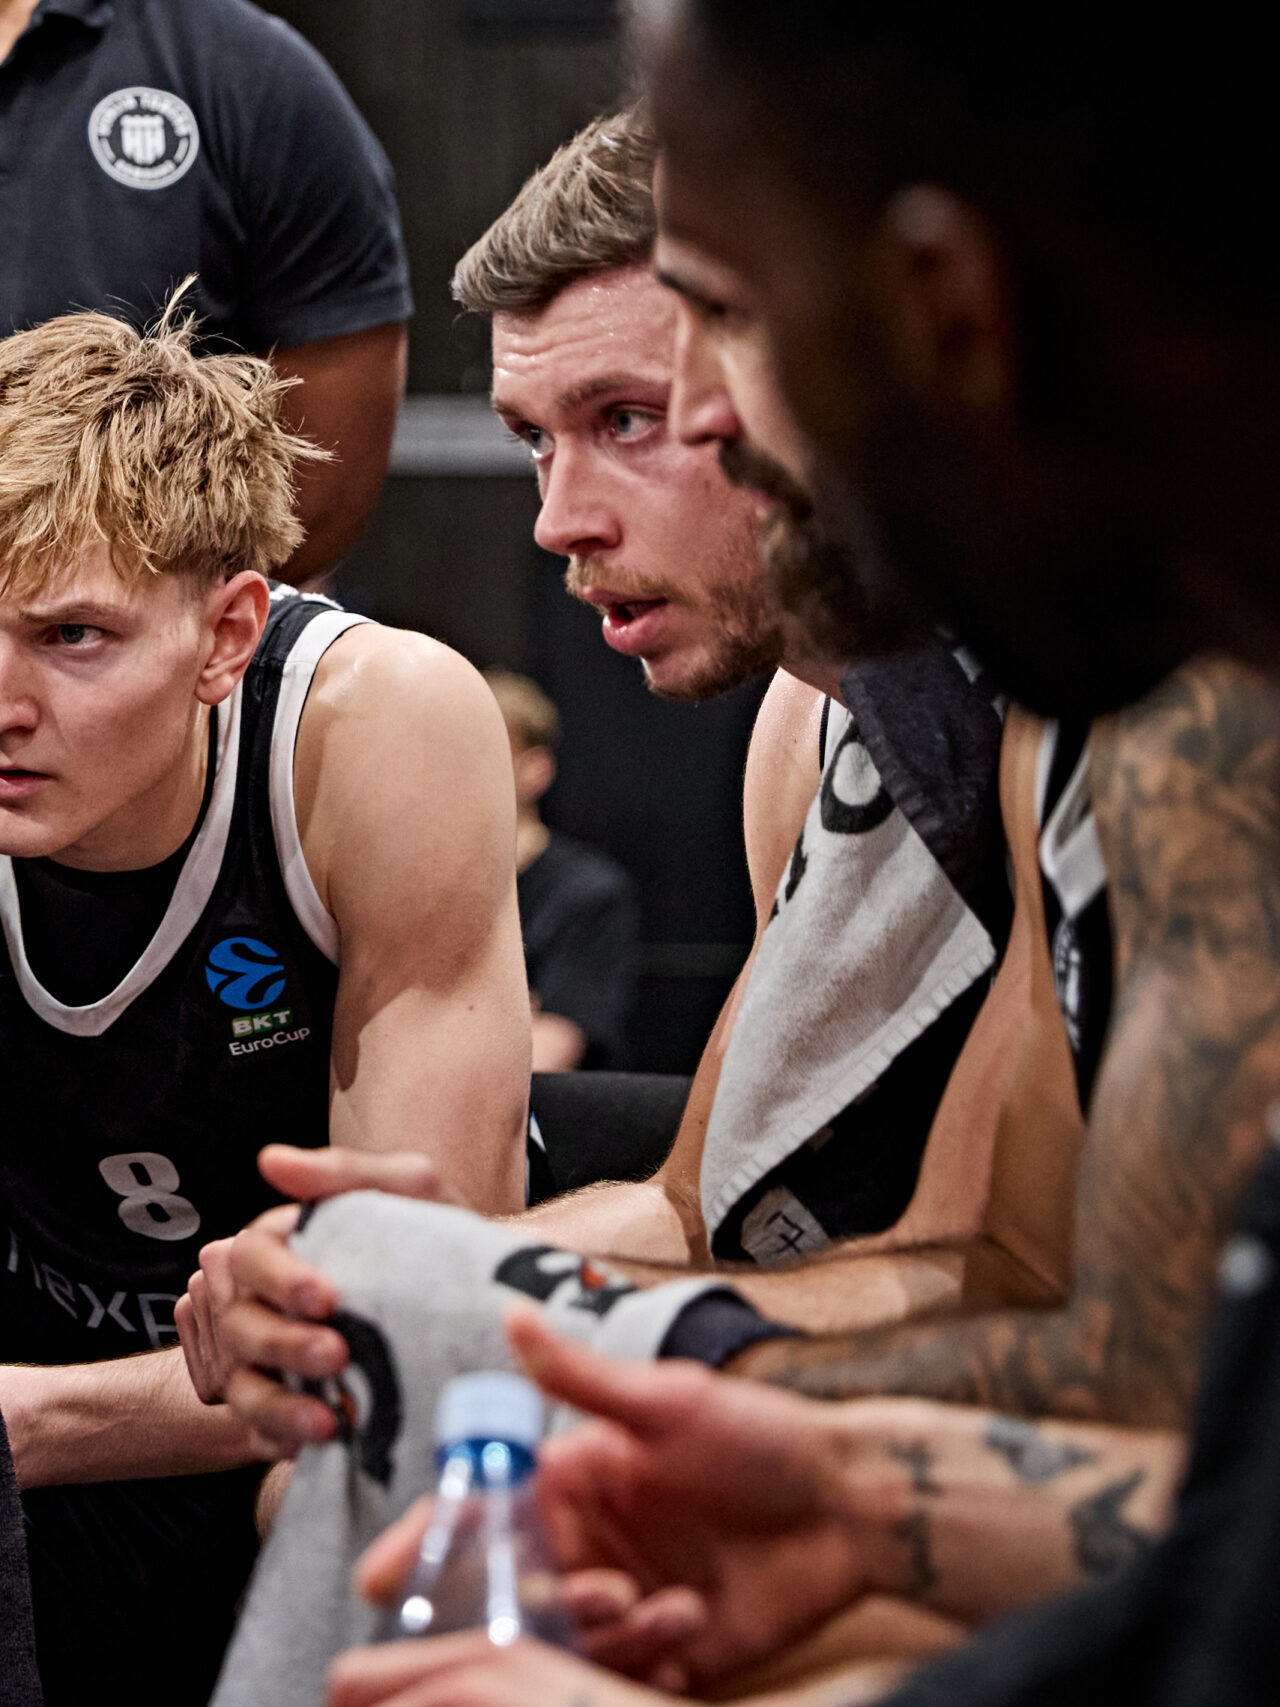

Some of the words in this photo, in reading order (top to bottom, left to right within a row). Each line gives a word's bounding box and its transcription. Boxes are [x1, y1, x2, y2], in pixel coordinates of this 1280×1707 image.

[232, 1010, 291, 1035] BKT
[228, 1027, 311, 1056] EuroCup
[98, 1151, 201, 1241] 8
